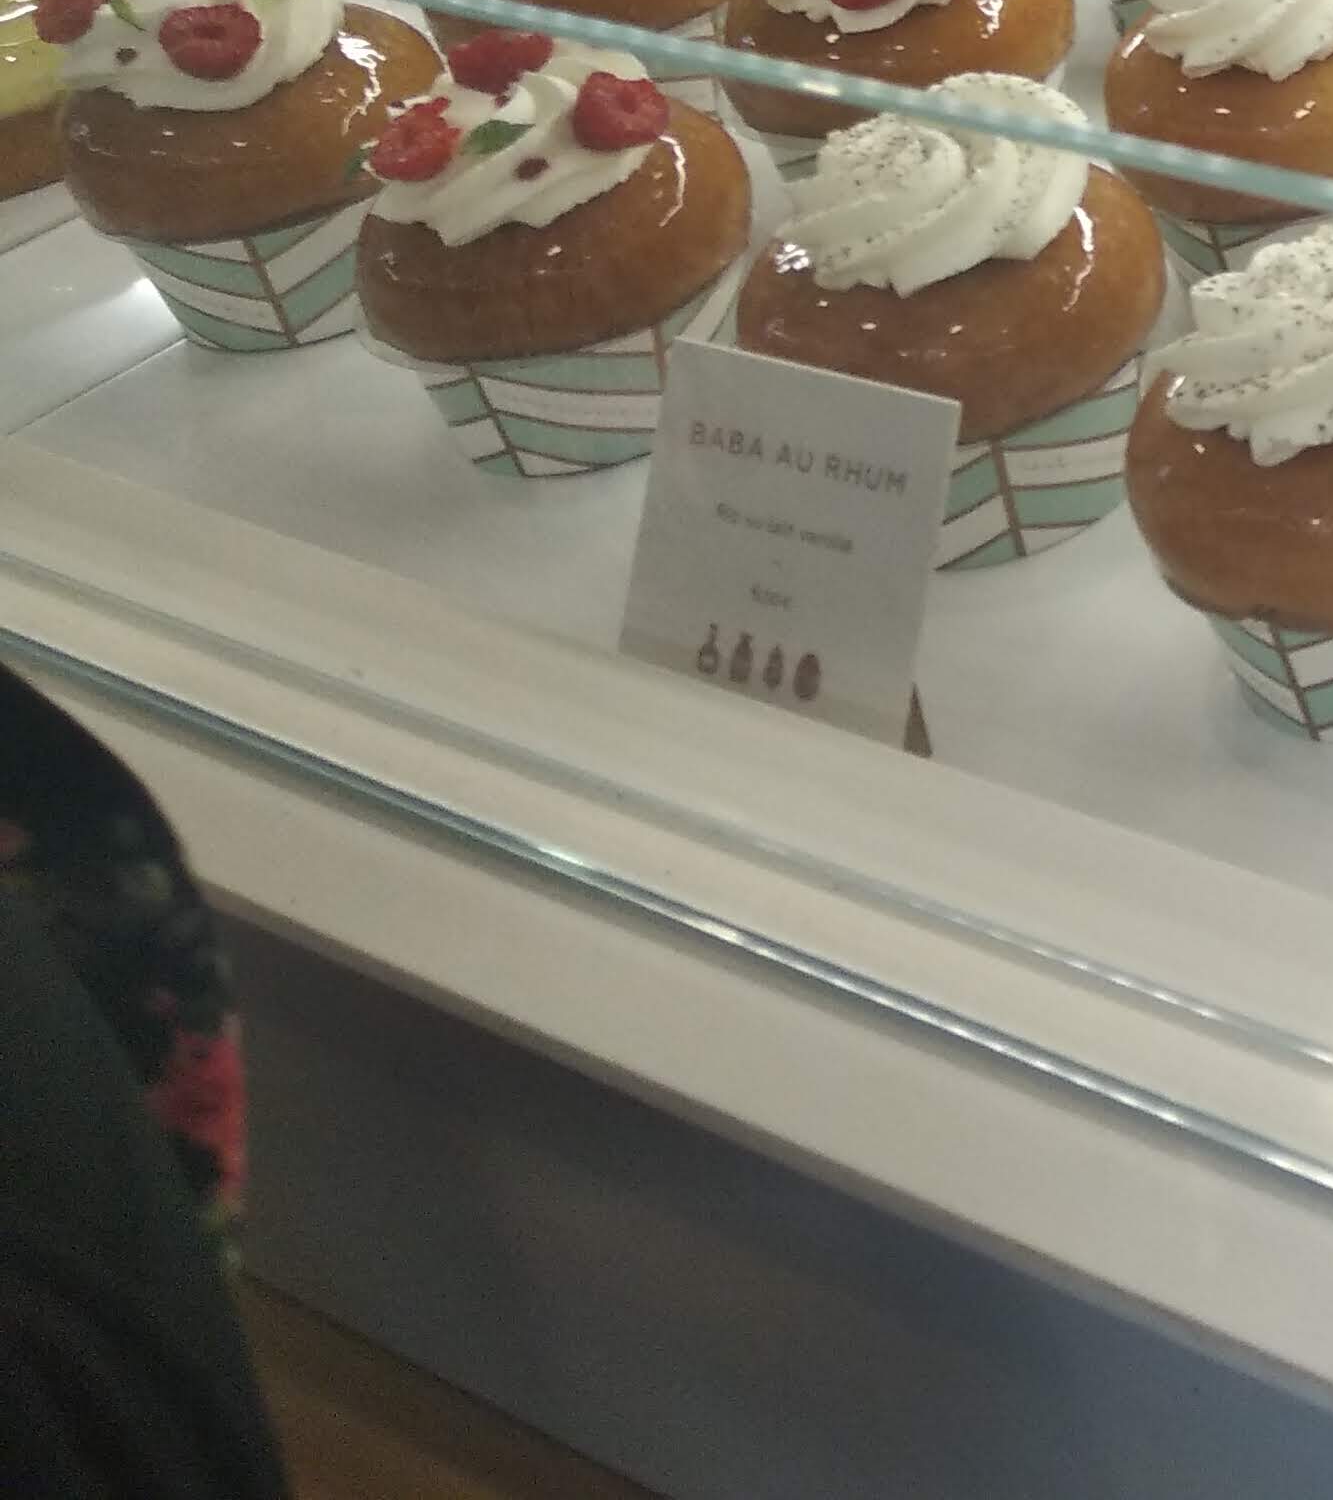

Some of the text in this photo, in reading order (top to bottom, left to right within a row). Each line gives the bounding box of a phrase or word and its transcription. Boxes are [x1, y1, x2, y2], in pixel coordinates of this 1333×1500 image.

[689, 420, 907, 496] BABA AU RHUM
